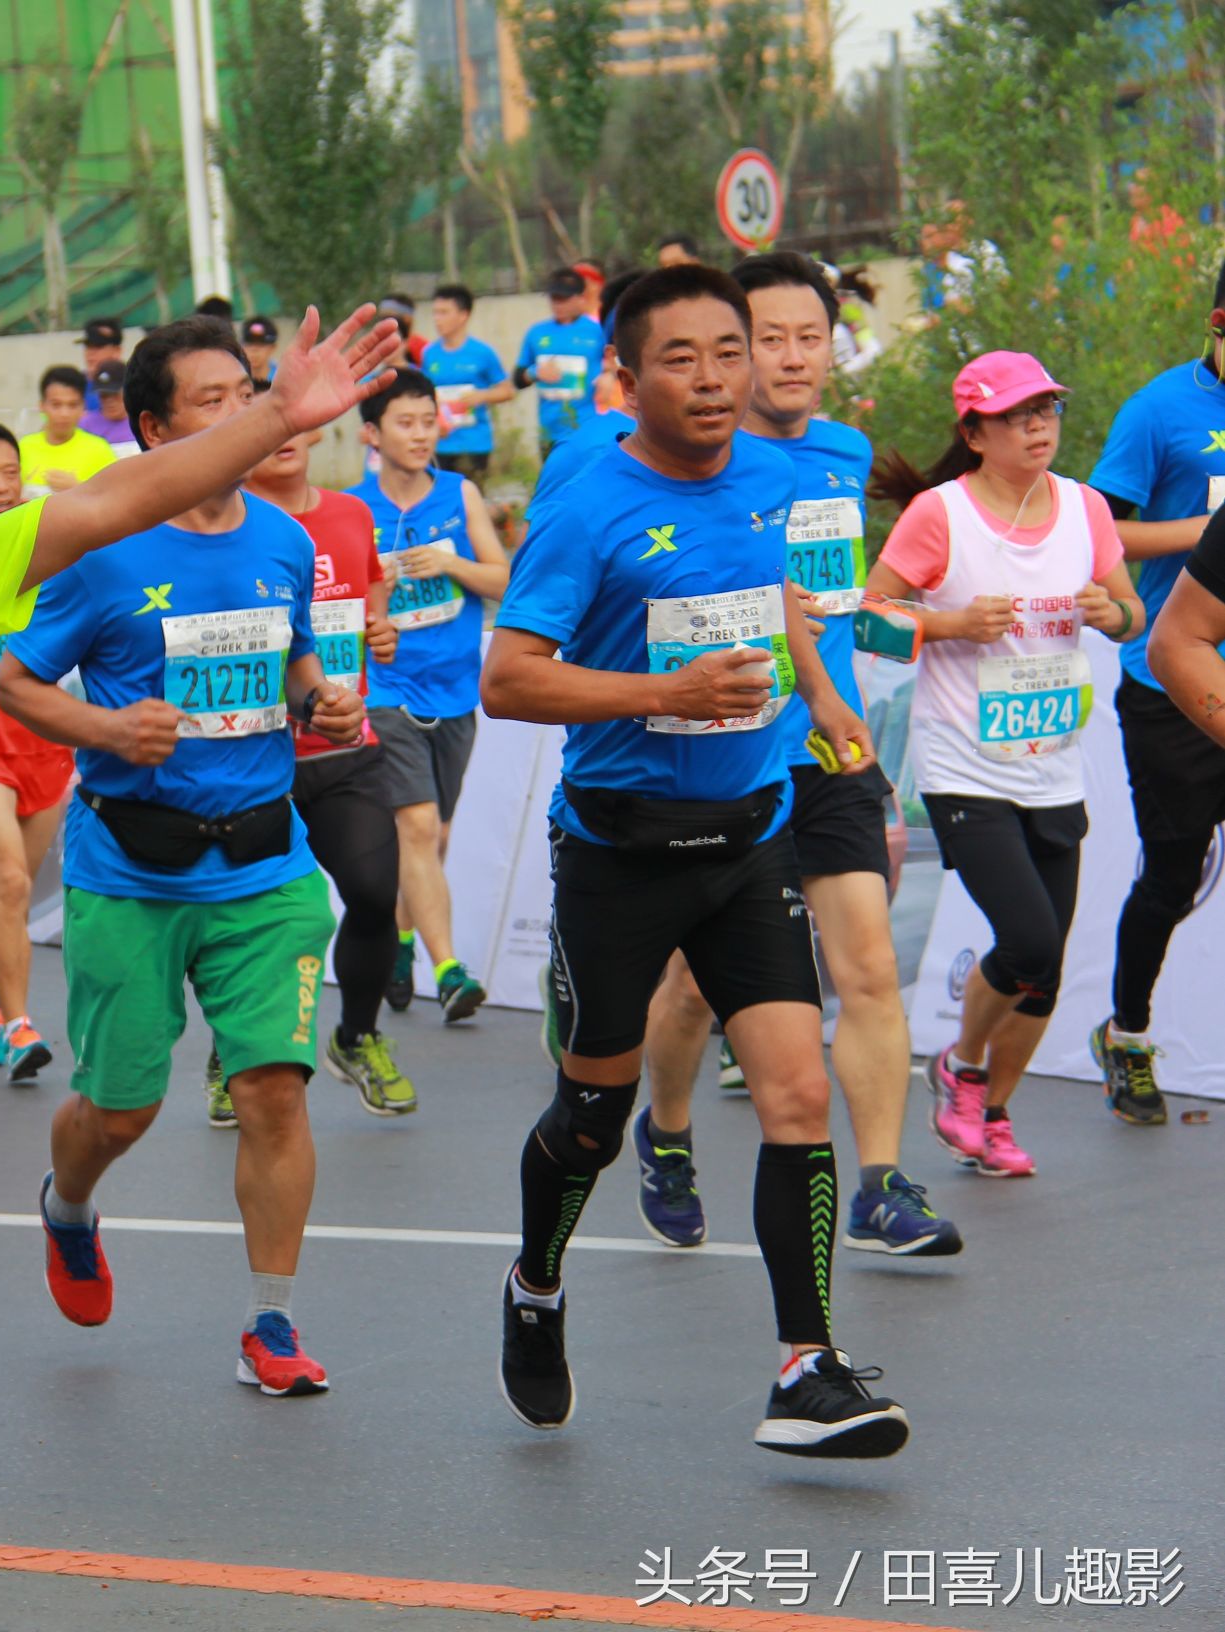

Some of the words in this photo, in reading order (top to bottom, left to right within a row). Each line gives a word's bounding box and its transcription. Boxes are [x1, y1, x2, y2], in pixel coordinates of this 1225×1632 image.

[737, 176, 770, 222] 30
[790, 547, 846, 588] 3743
[201, 645, 243, 656] C-TREK
[691, 629, 737, 643] C-TREK
[180, 660, 269, 709] 21278
[986, 694, 1074, 739] 26424
